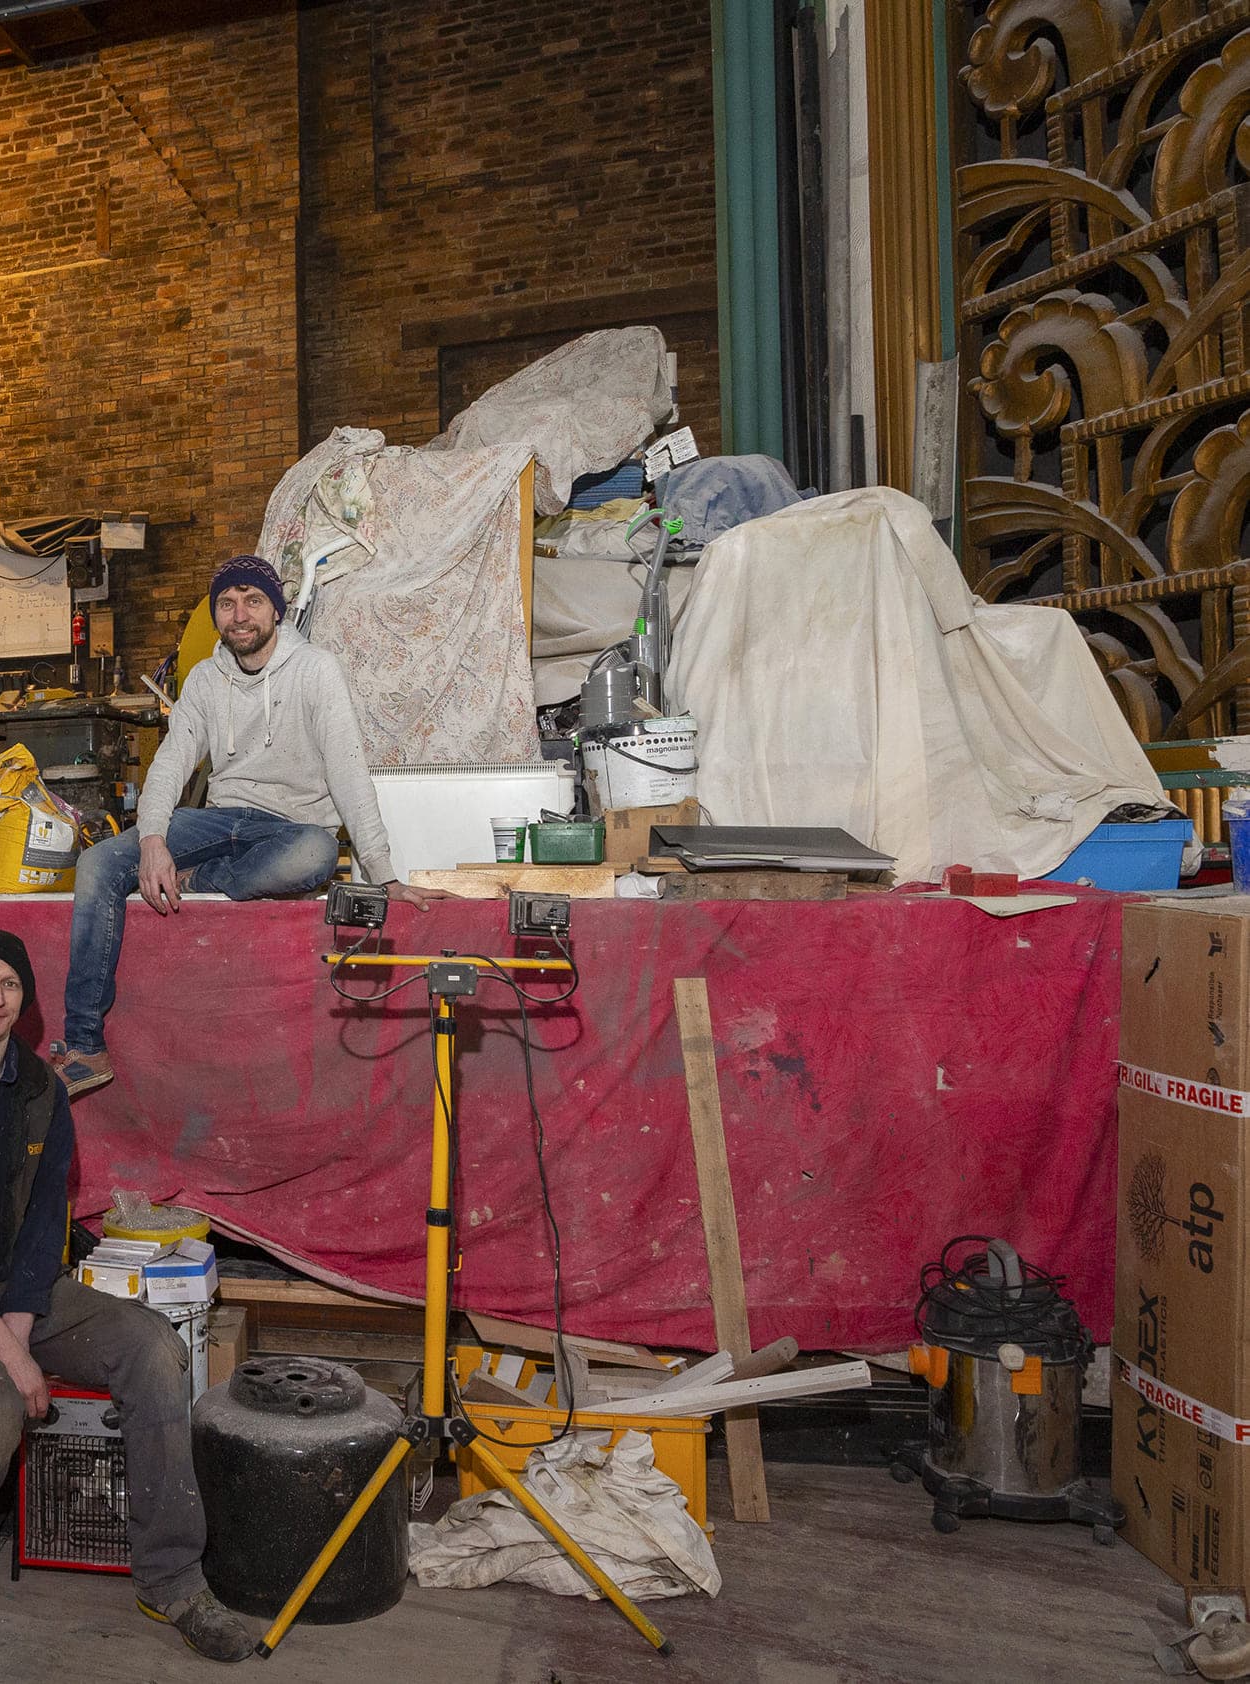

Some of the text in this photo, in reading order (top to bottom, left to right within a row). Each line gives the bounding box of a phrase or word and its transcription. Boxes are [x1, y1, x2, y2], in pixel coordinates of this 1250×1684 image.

[646, 744, 679, 755] magnolia
[1167, 1080, 1243, 1114] FRAGILE
[1182, 1182, 1224, 1274] atp
[1137, 1285, 1159, 1460] KYDEX
[1138, 1377, 1203, 1425] FRAGILE
[1159, 1295, 1167, 1463] THERMPLASTICS
